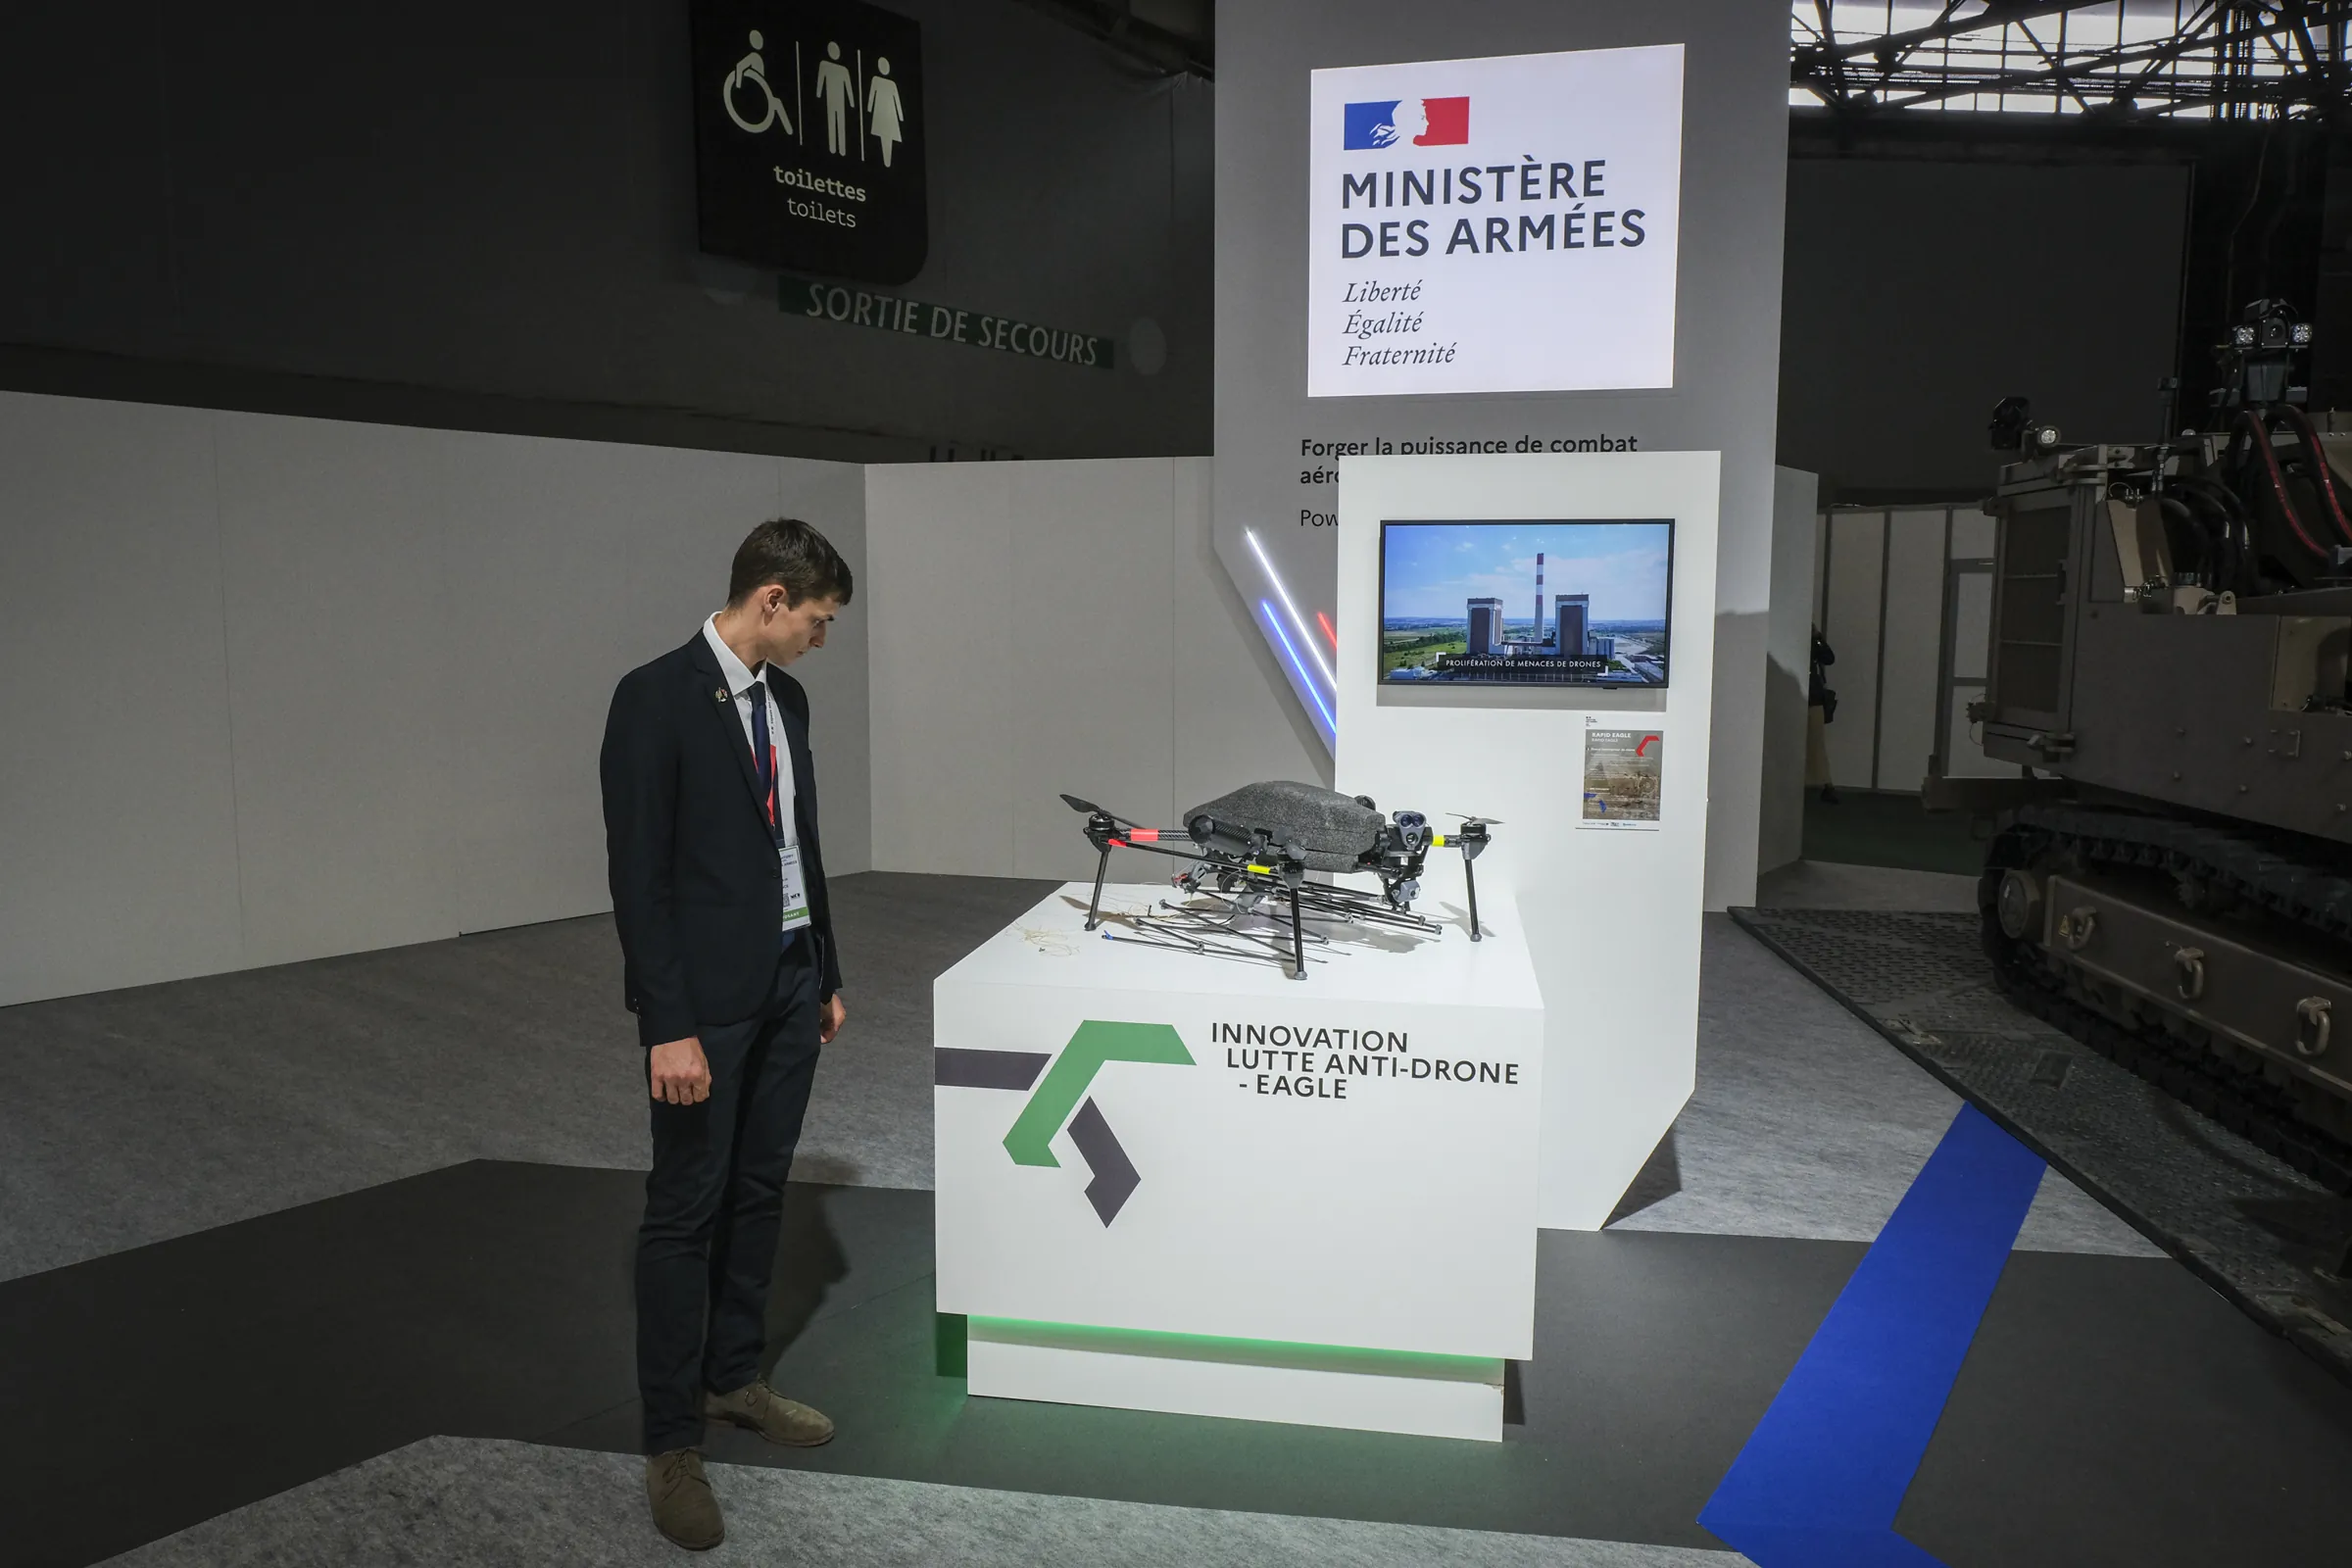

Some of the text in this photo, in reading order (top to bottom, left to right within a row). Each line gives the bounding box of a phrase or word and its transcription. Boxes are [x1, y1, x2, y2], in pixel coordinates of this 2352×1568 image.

[773, 165, 866, 202] toilettes
[1342, 154, 1607, 210] MINISTÈRE
[787, 197, 857, 228] toilets
[1342, 203, 1646, 259] DES ARMÉES
[1342, 279, 1421, 304] Liberté
[805, 282, 1099, 367] SORTIE DE SECOURS
[1342, 309, 1423, 339] Égalité
[1342, 342, 1455, 368] Fraternité
[1300, 433, 1639, 462] Forger la puissance de combat
[1446, 658, 1601, 668] PROLIFÉRATION DE MENACES DE DRONES
[1211, 1022, 1408, 1054] INNOVATION
[1227, 1048, 1519, 1085] LUTTE ANTI-DRONE
[1256, 1074, 1348, 1100] EAGLE
